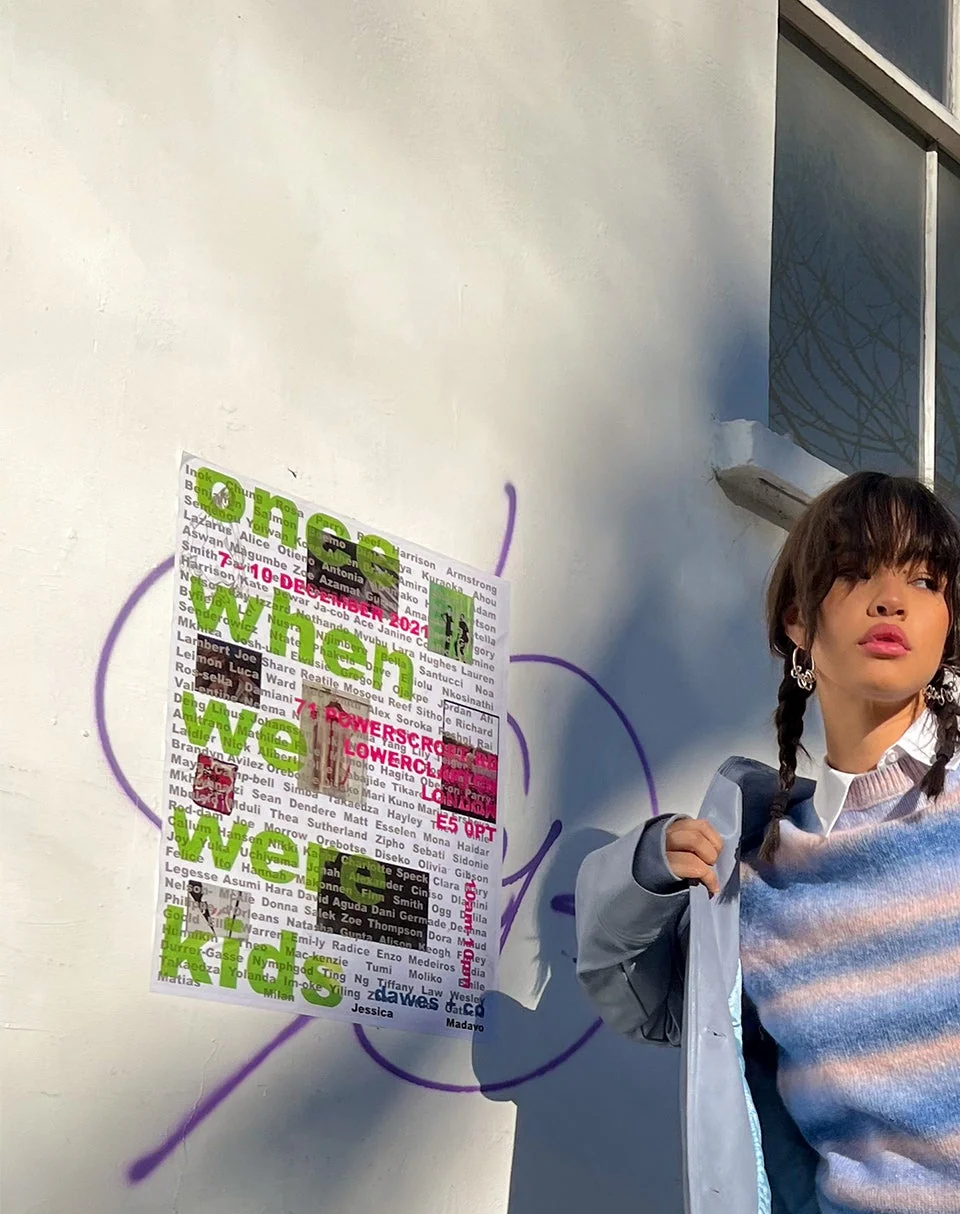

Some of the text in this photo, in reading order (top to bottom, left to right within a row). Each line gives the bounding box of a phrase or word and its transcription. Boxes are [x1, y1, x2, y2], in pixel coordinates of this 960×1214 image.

[182, 541, 217, 561] Smith
[183, 509, 232, 535] Lazarus
[239, 530, 269, 549] Alice
[277, 545, 314, 566] Otieno
[322, 561, 363, 584] Antonia
[195, 467, 399, 586] once
[225, 480, 262, 503] Chung
[276, 499, 303, 518] Rosa
[316, 515, 345, 536] Parry
[356, 531, 380, 548] Reef
[392, 545, 435, 570] Harrison
[446, 566, 496, 595] Armstrong
[254, 507, 296, 530] Salmon
[422, 571, 462, 594] Kuraoka
[473, 591, 496, 606] Ahou
[182, 524, 223, 547] Aswan
[229, 542, 287, 570] Magumbe
[293, 565, 313, 580] Zoe
[319, 575, 360, 597] Azamat
[181, 555, 411, 643] Harrison Kate Dewar Ja-cob Ace Janine
[217, 550, 230, 569] 7
[250, 562, 272, 584] 10
[280, 573, 384, 623] DECEMBER
[389, 612, 428, 638] 2021
[178, 600, 493, 710] Senderowicz Nkosinathi
[191, 575, 413, 701] when
[256, 596, 494, 684] Izzard Nothando Mvubu Lara Hughes Lauren
[174, 692, 244, 720] Deng Linus
[176, 662, 232, 687] Ros-sella
[245, 682, 292, 704] Damiani
[176, 646, 492, 750] Leimon Luca Ward Alex Soroka Rai
[177, 631, 230, 655] Lambert
[234, 649, 256, 664] Joe
[261, 658, 295, 676] Share
[301, 670, 338, 689] Reatile
[343, 683, 383, 703] Mosoeu
[388, 697, 411, 712] Reef
[456, 718, 492, 737] Richard
[294, 697, 317, 720] 71
[340, 668, 382, 690] Gregory
[419, 666, 493, 698] Santucci Noa
[172, 723, 250, 752] Laidler Nick
[173, 709, 229, 731] Amitrano
[238, 726, 288, 747] Mathilde
[381, 766, 414, 782] Hagita
[183, 691, 306, 773] we
[382, 738, 429, 760] Yang Lily
[228, 753, 414, 809] Avilez Mari Kuno
[166, 831, 297, 868] Joy Yuka Uchiyama
[233, 816, 488, 883] Joe Morrow Orebotse Diseko Olivia Gibson
[252, 790, 489, 856] Sean Dendere Matt Esselen Mona Haidar
[270, 809, 488, 870] Thea Sutherland Zipho Sebati Sidonie
[387, 809, 422, 827] Hayley
[436, 813, 457, 833] E5
[166, 847, 451, 917] Felice Ito Hannah Finn Smith Ogg
[167, 815, 459, 890] Callum Hansen Nikki Speck Clara
[174, 807, 385, 904] were
[165, 863, 449, 929] Legesse Asumi Hara David Aguda Dani Germade
[262, 897, 451, 943] Donna Salek Zoe Thompson Dora
[159, 903, 343, 1007] kids
[238, 938, 442, 982] Theo Mac-kenzie Tumi Moliko
[287, 917, 450, 957] Natasha Gupta Alison Keogh
[291, 933, 455, 971] Emi-ly Radice Enzo Medeiros
[157, 972, 483, 1032] Matias Milan Jessica Madavo
[229, 967, 276, 984] Yolanda
[330, 985, 360, 999] Yiling
[252, 956, 442, 997] Nymphgod Ting Ng Tiffany Law
[374, 985, 438, 1010] dawes
